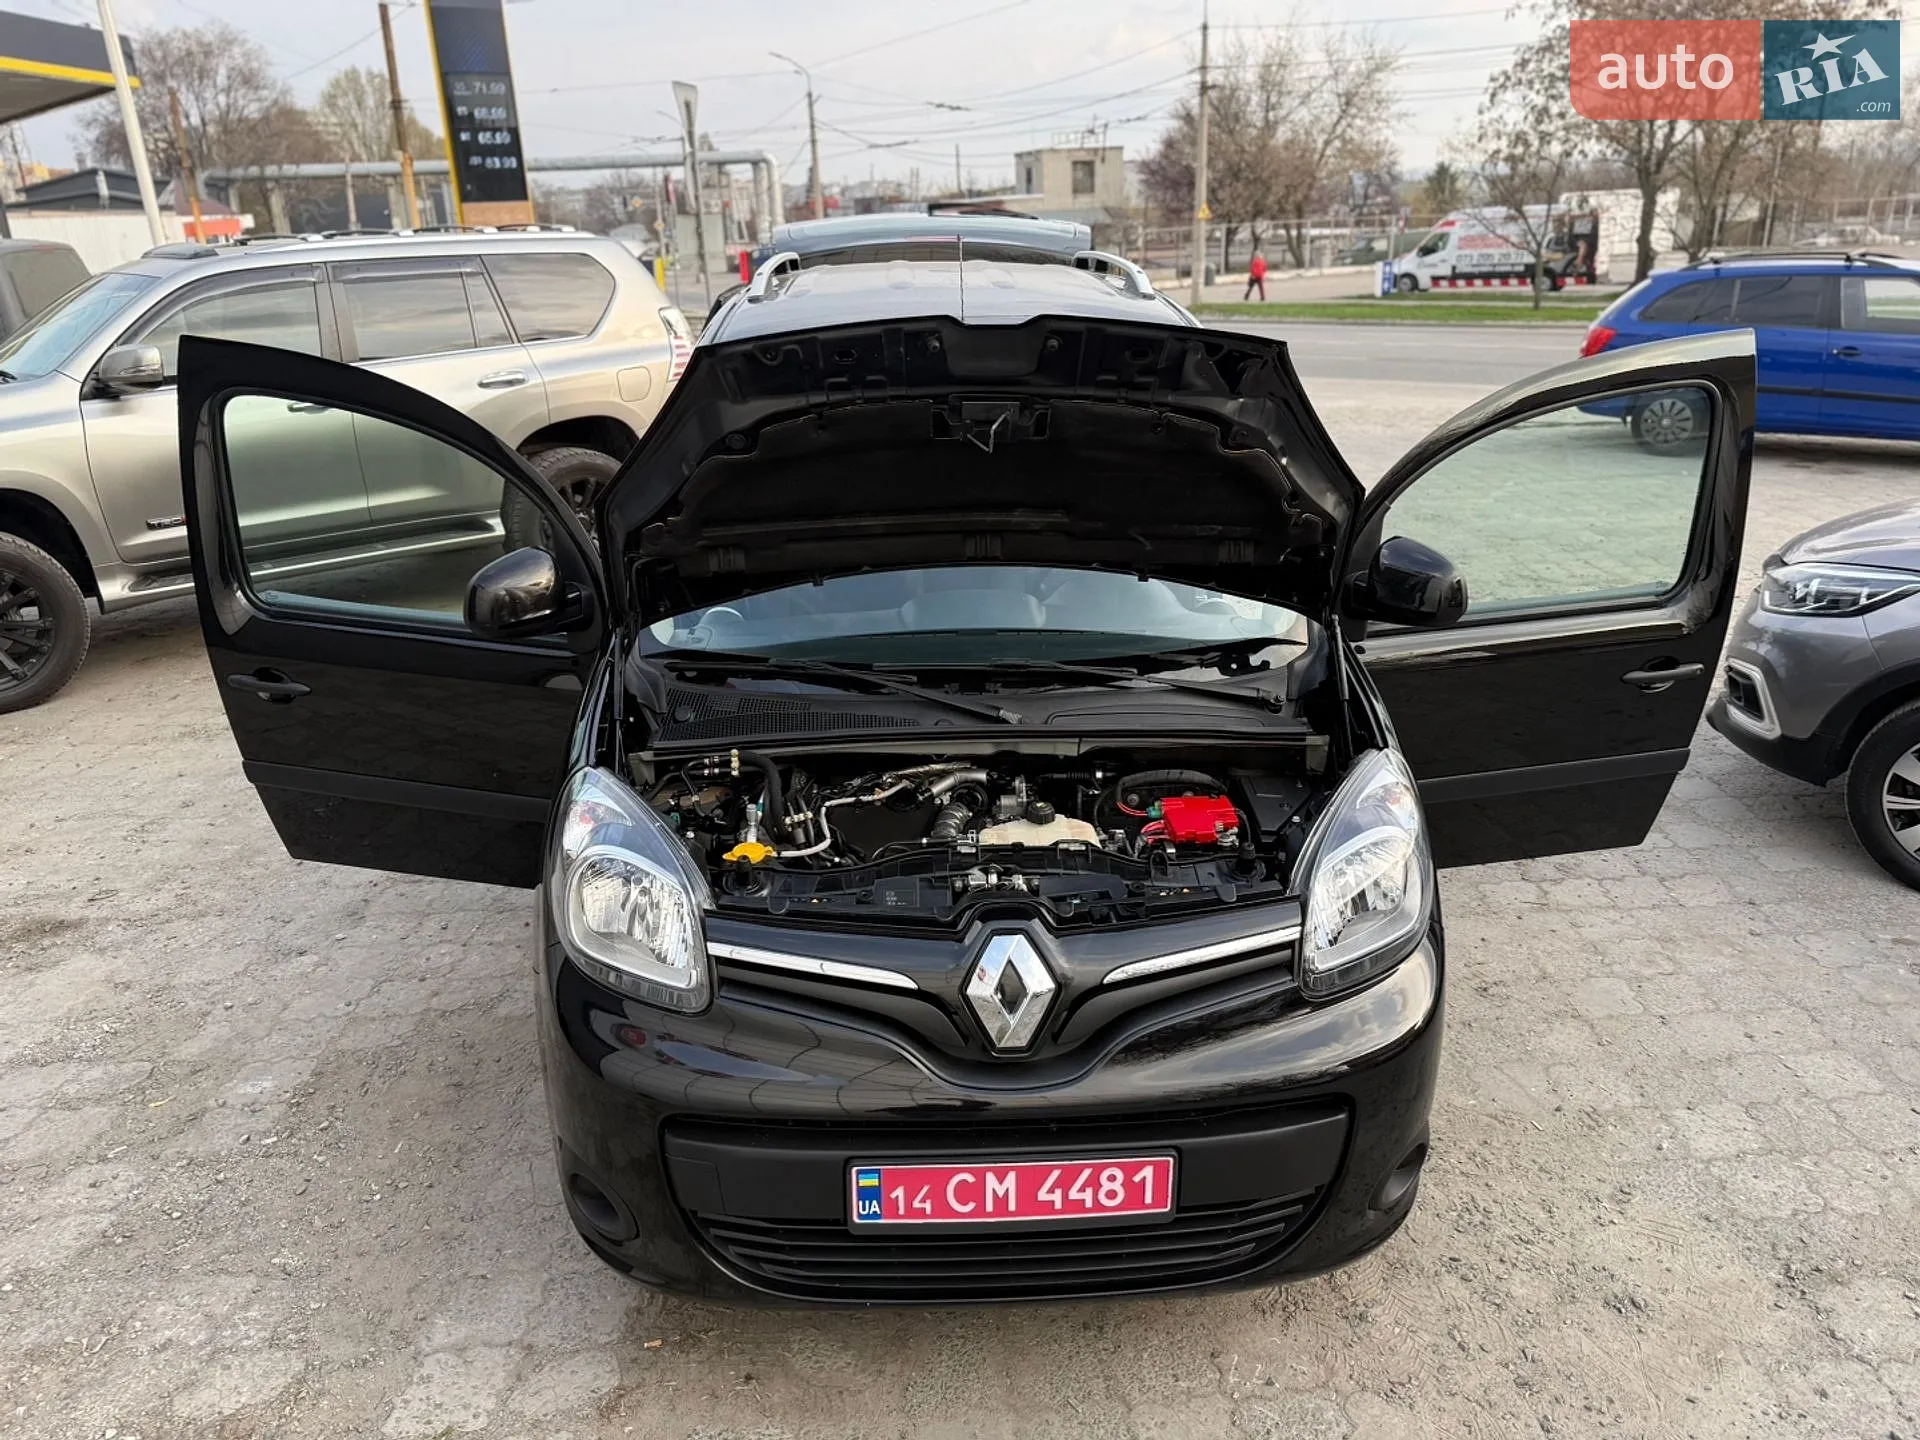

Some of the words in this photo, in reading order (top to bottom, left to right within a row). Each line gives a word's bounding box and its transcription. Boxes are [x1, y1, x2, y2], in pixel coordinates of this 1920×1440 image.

[889, 1185, 931, 1215] 14
[946, 1170, 1016, 1213] CM
[1037, 1165, 1154, 1210] 4481
[858, 1200, 880, 1215] UA
